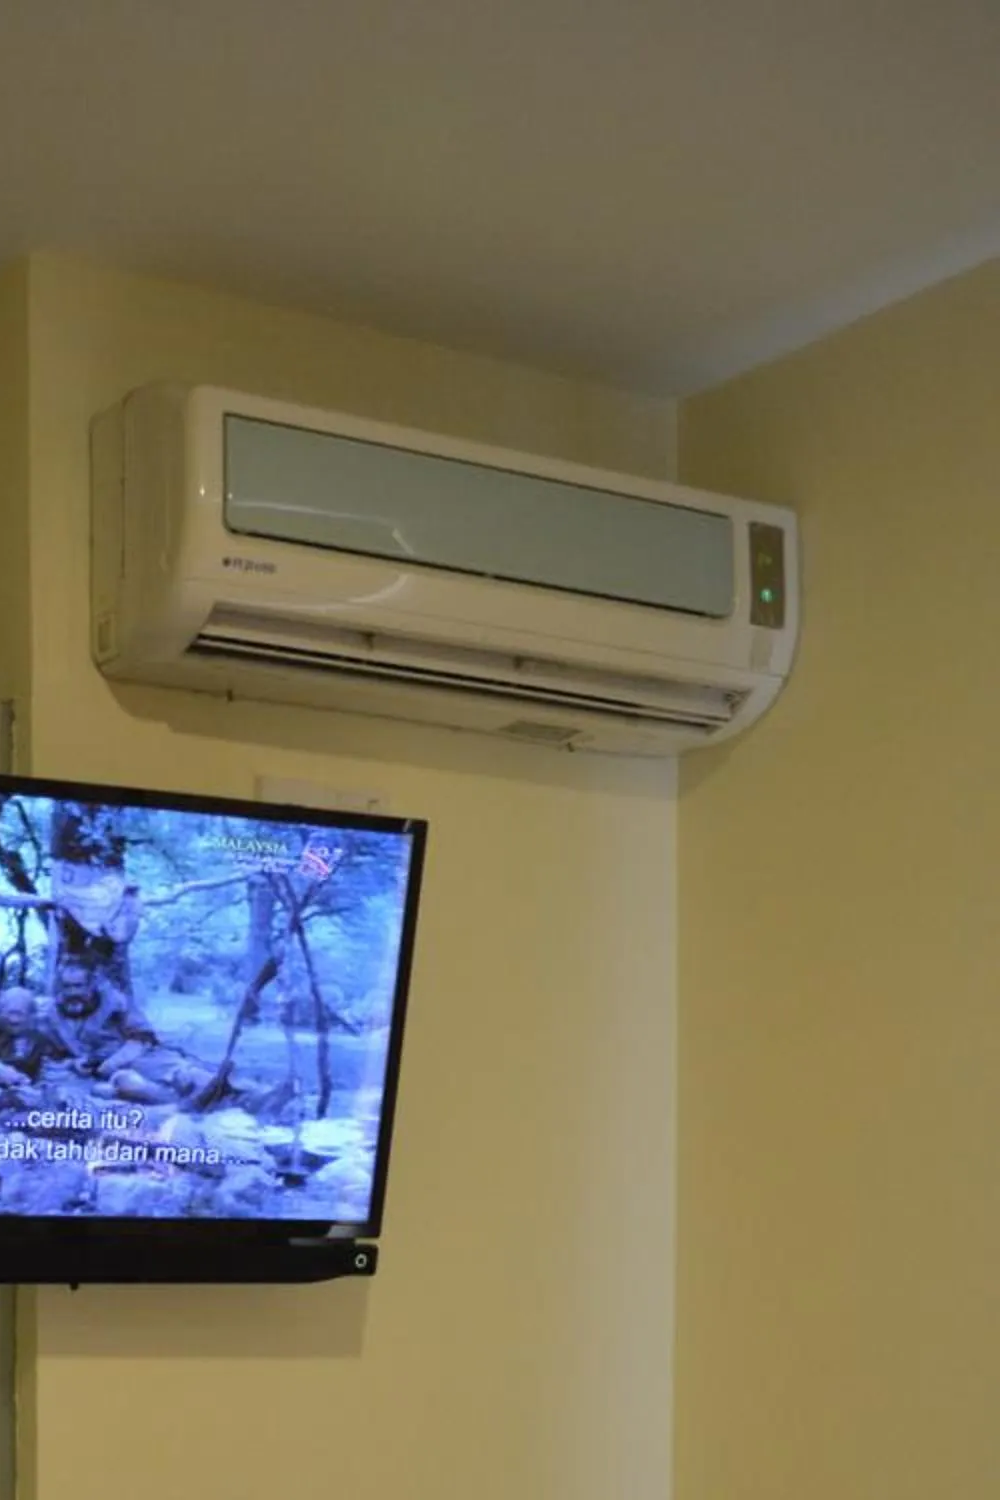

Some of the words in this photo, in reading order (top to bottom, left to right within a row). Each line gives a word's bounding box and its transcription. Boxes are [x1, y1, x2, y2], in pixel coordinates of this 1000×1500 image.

[101, 1108, 144, 1130] itu?
[46, 1139, 99, 1162] tahu
[105, 1140, 149, 1163] dari
